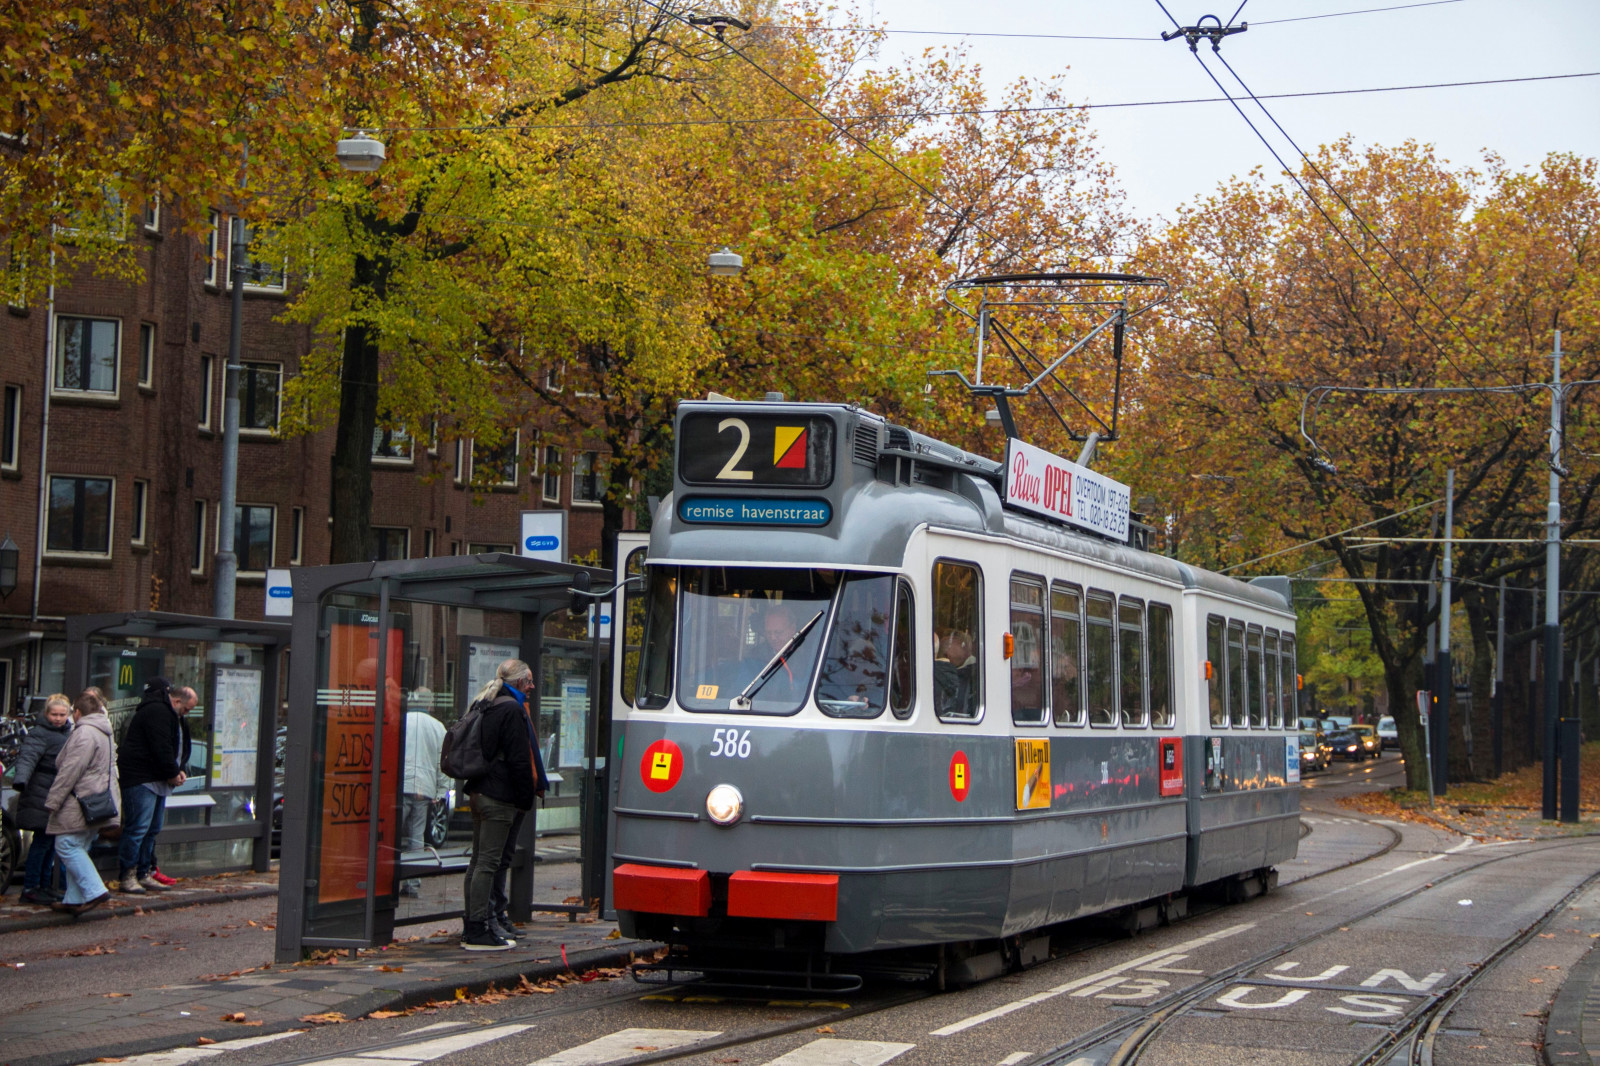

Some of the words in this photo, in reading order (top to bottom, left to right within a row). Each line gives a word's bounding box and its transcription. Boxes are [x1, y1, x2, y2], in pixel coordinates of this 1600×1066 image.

[715, 417, 754, 480] 2
[1010, 451, 1041, 505] Riva
[1043, 463, 1073, 517] OPEL
[1075, 475, 1106, 507] OVERTOOM
[1108, 488, 1128, 515] 197-205
[686, 504, 734, 518] remise
[741, 504, 825, 520] havenstraat
[701, 686, 713, 697] 10
[334, 733, 373, 768] ADS
[710, 728, 751, 758] 586
[1018, 742, 1044, 771] Willem
[1070, 976, 1410, 1018] BUS
